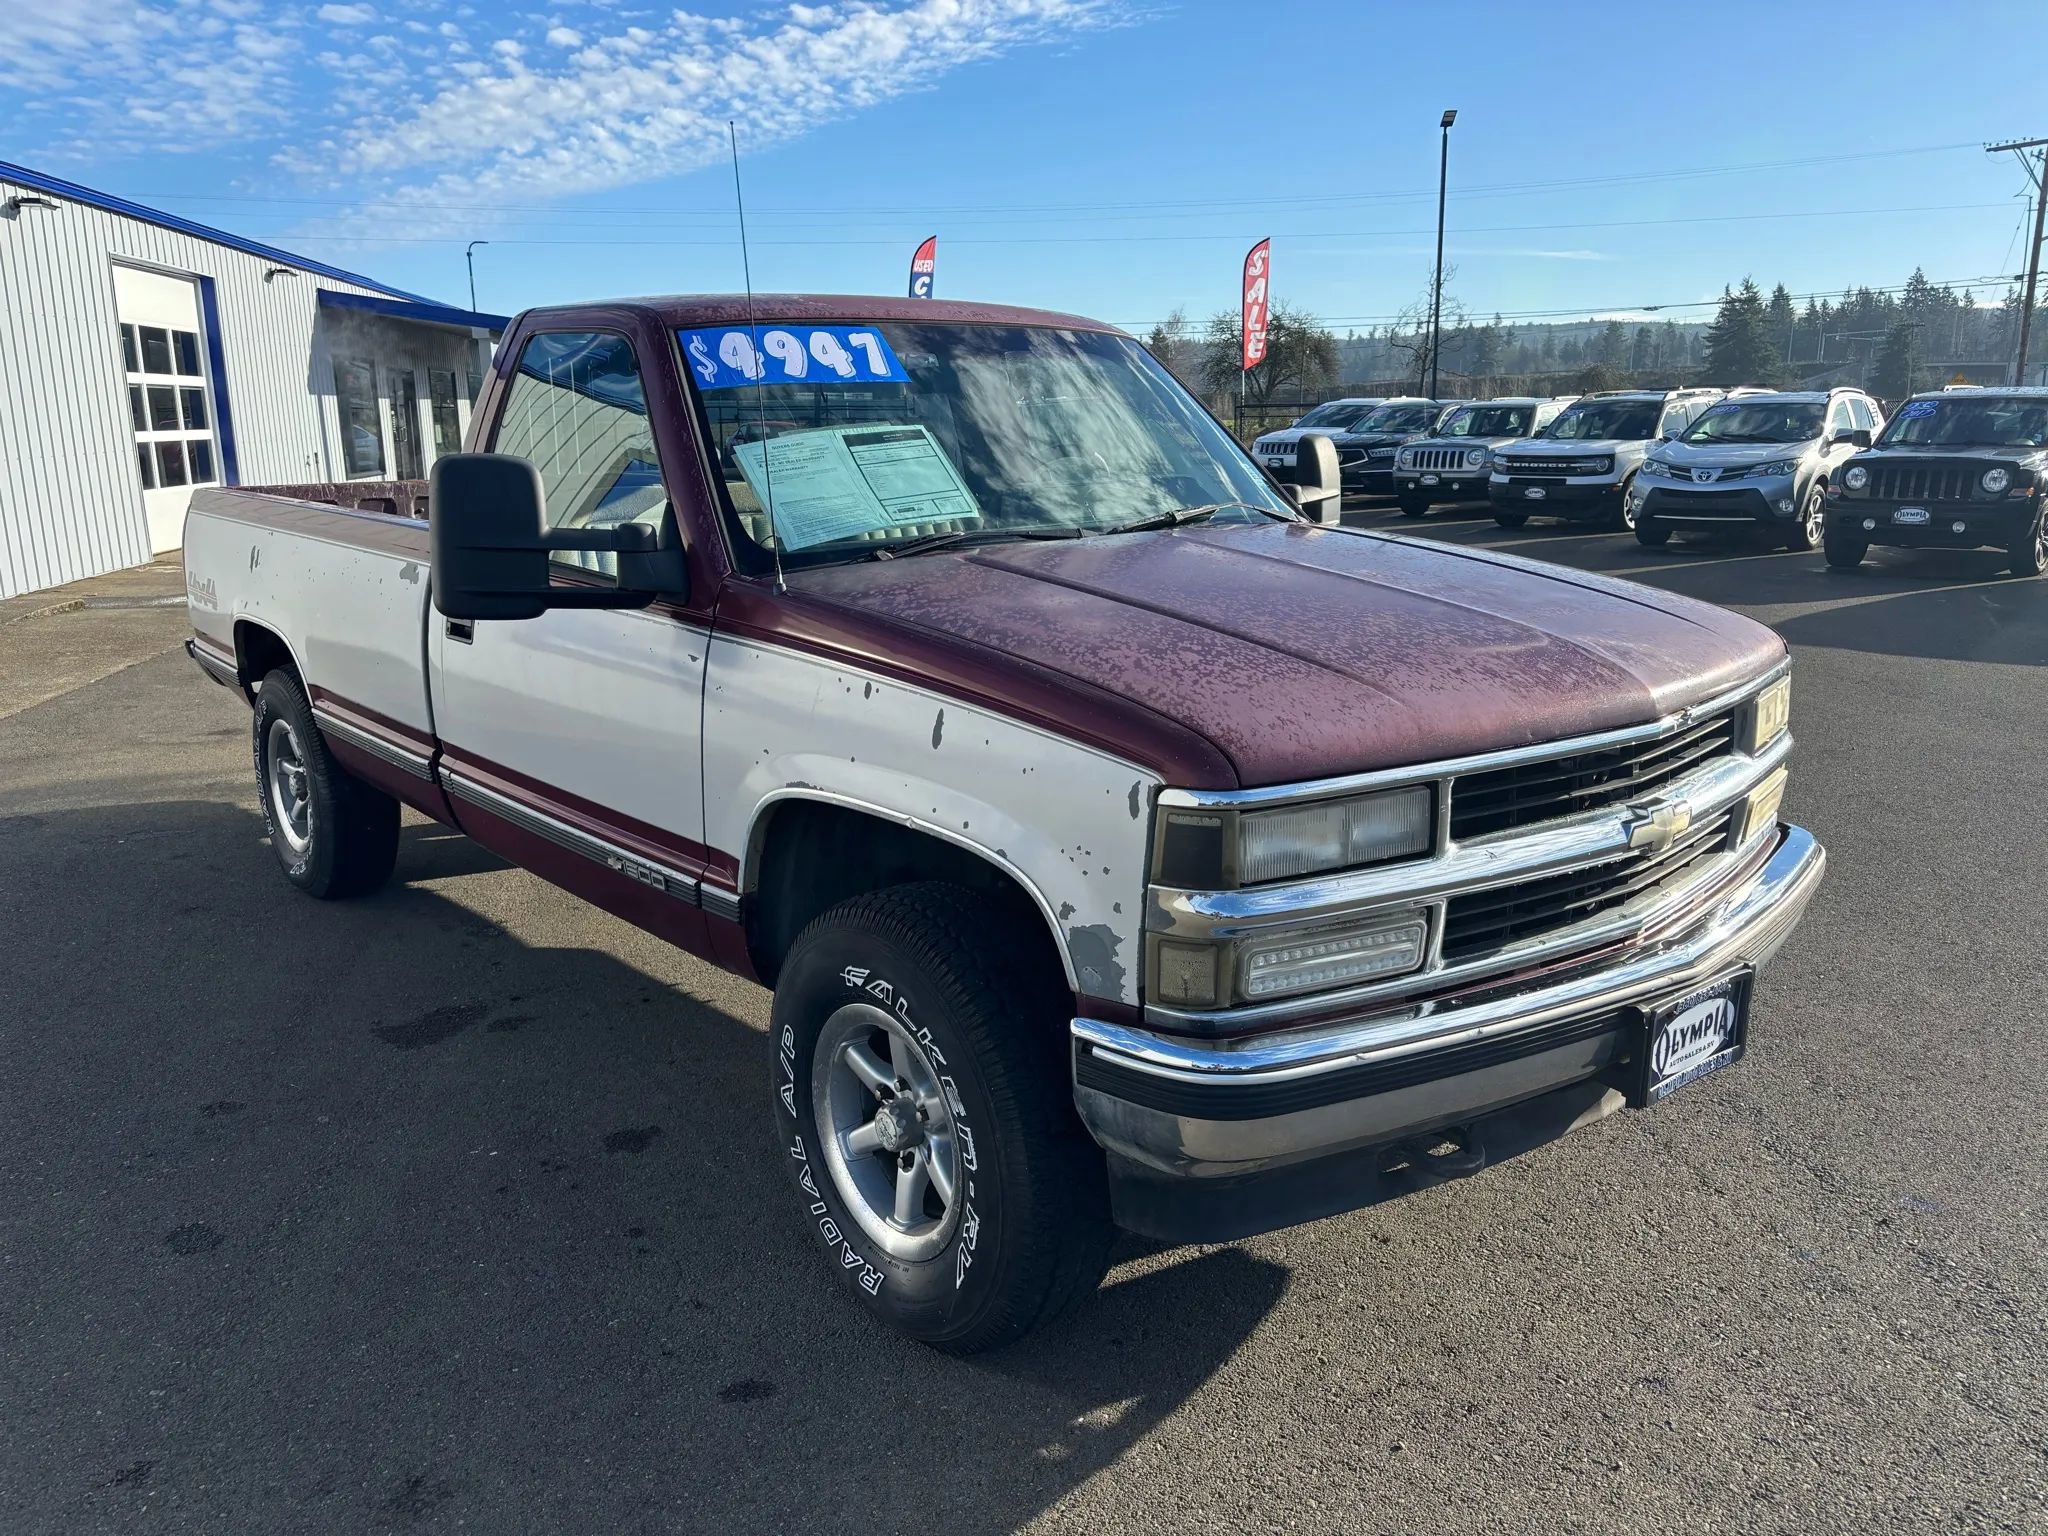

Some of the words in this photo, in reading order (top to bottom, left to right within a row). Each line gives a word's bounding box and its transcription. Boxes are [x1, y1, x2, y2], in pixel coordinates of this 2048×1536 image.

[914, 276, 930, 298] C
[1246, 249, 1268, 358] SALE
[689, 330, 891, 384] $4947
[780, 1024, 796, 1119] A/P
[1655, 996, 1729, 1079] OLYMPIA
[1669, 1056, 1684, 1068] AUTO
[1684, 1047, 1702, 1061] SALES
[790, 1135, 887, 1296] RADIAL
